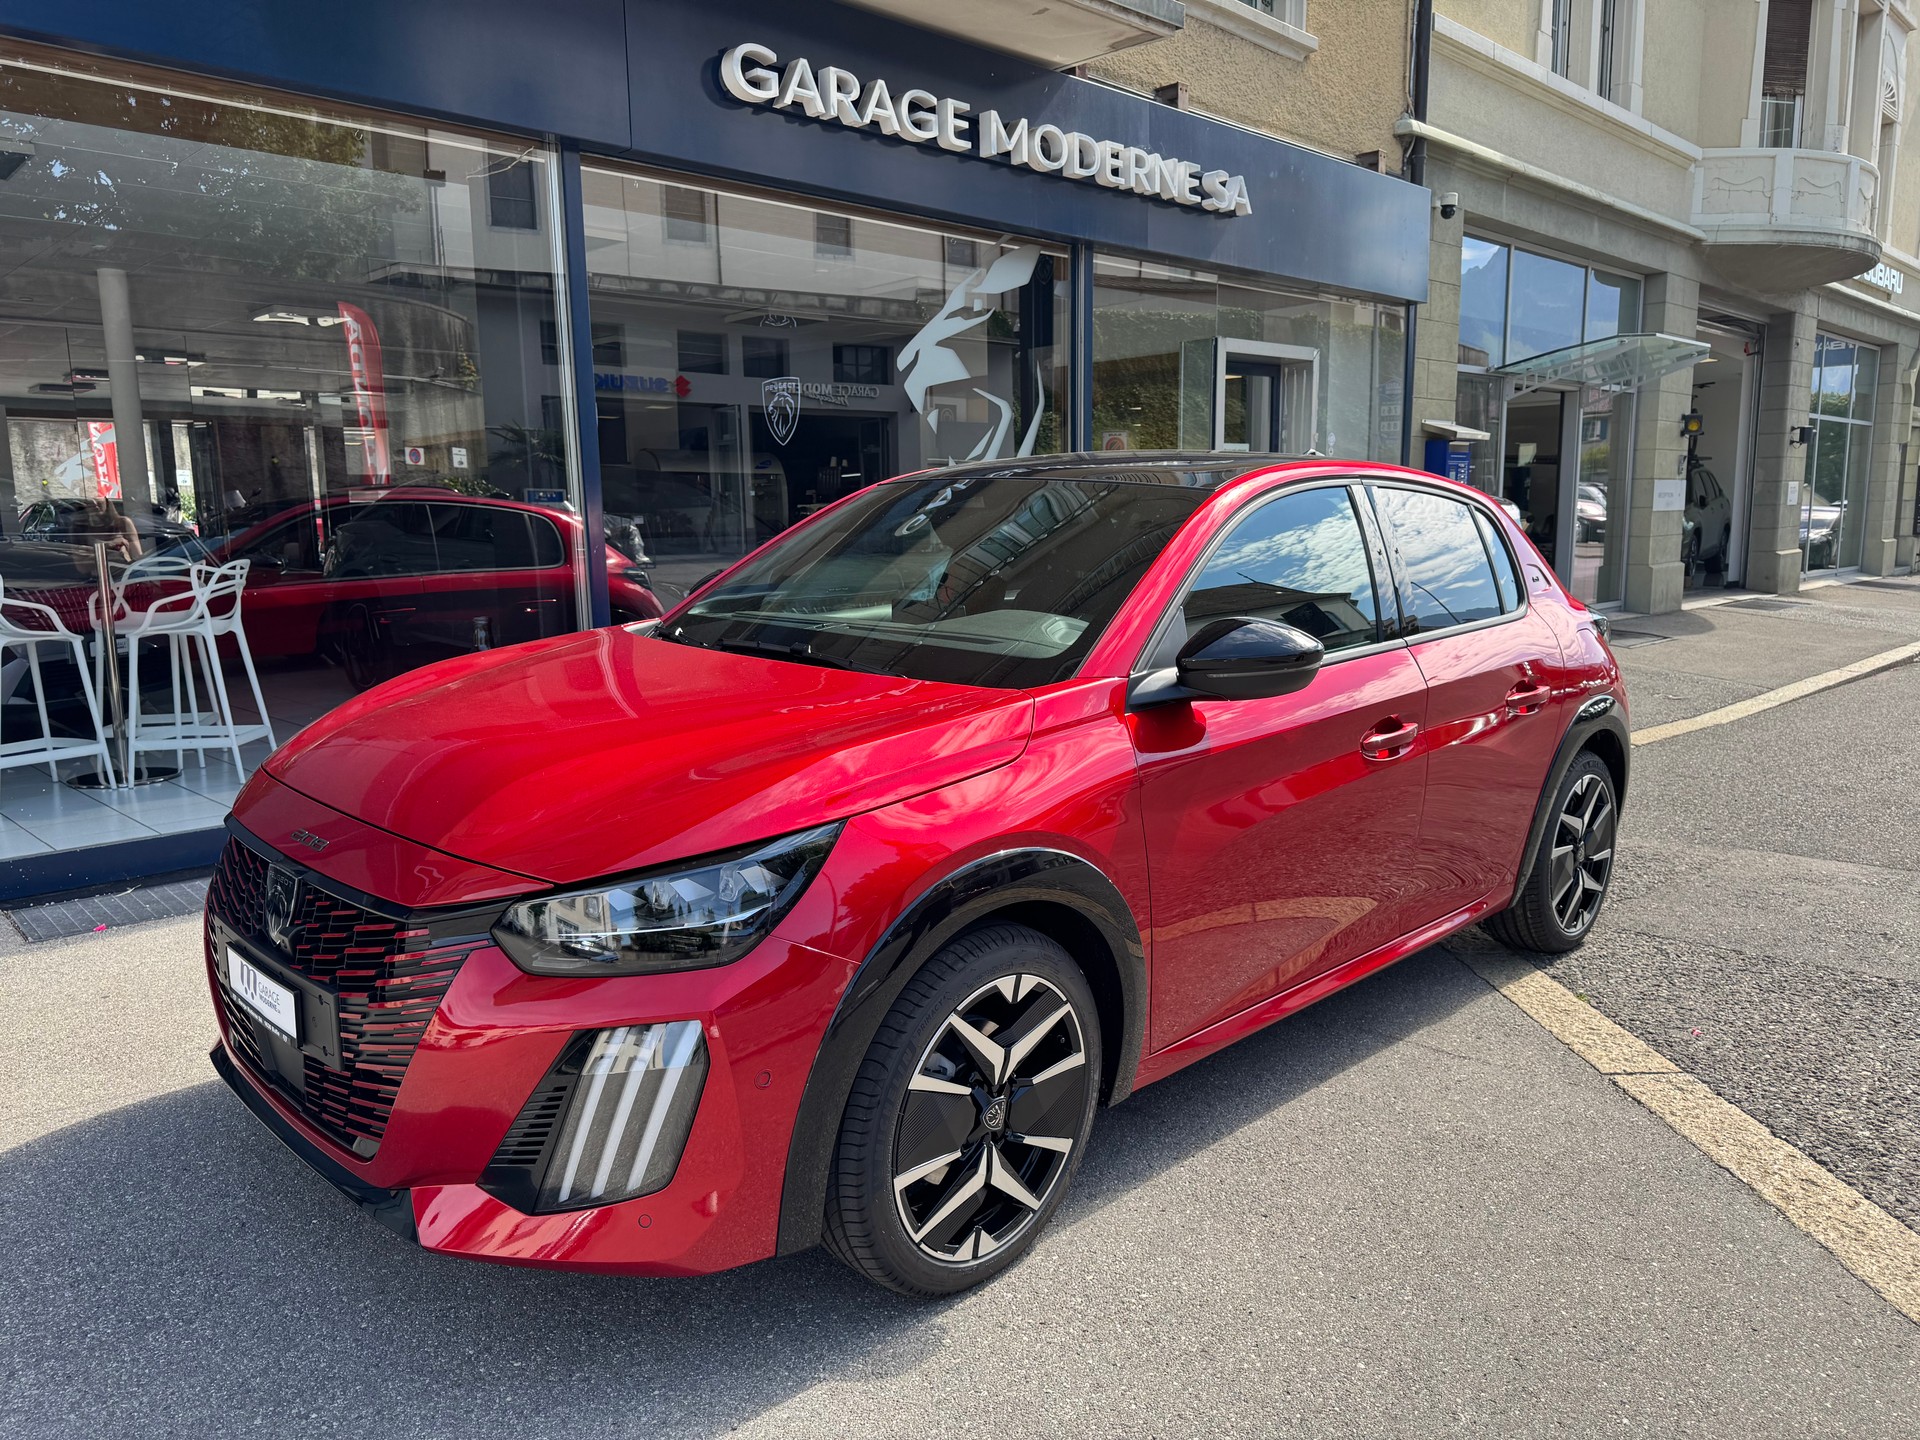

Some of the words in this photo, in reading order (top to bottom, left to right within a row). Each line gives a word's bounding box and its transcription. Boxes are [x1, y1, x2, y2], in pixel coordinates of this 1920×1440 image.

[720, 42, 972, 152] GARAGE
[765, 382, 796, 391] PEUGEOT
[290, 828, 330, 852] 208
[269, 870, 293, 888] PEUGEOT
[258, 981, 280, 1006] GARAGE
